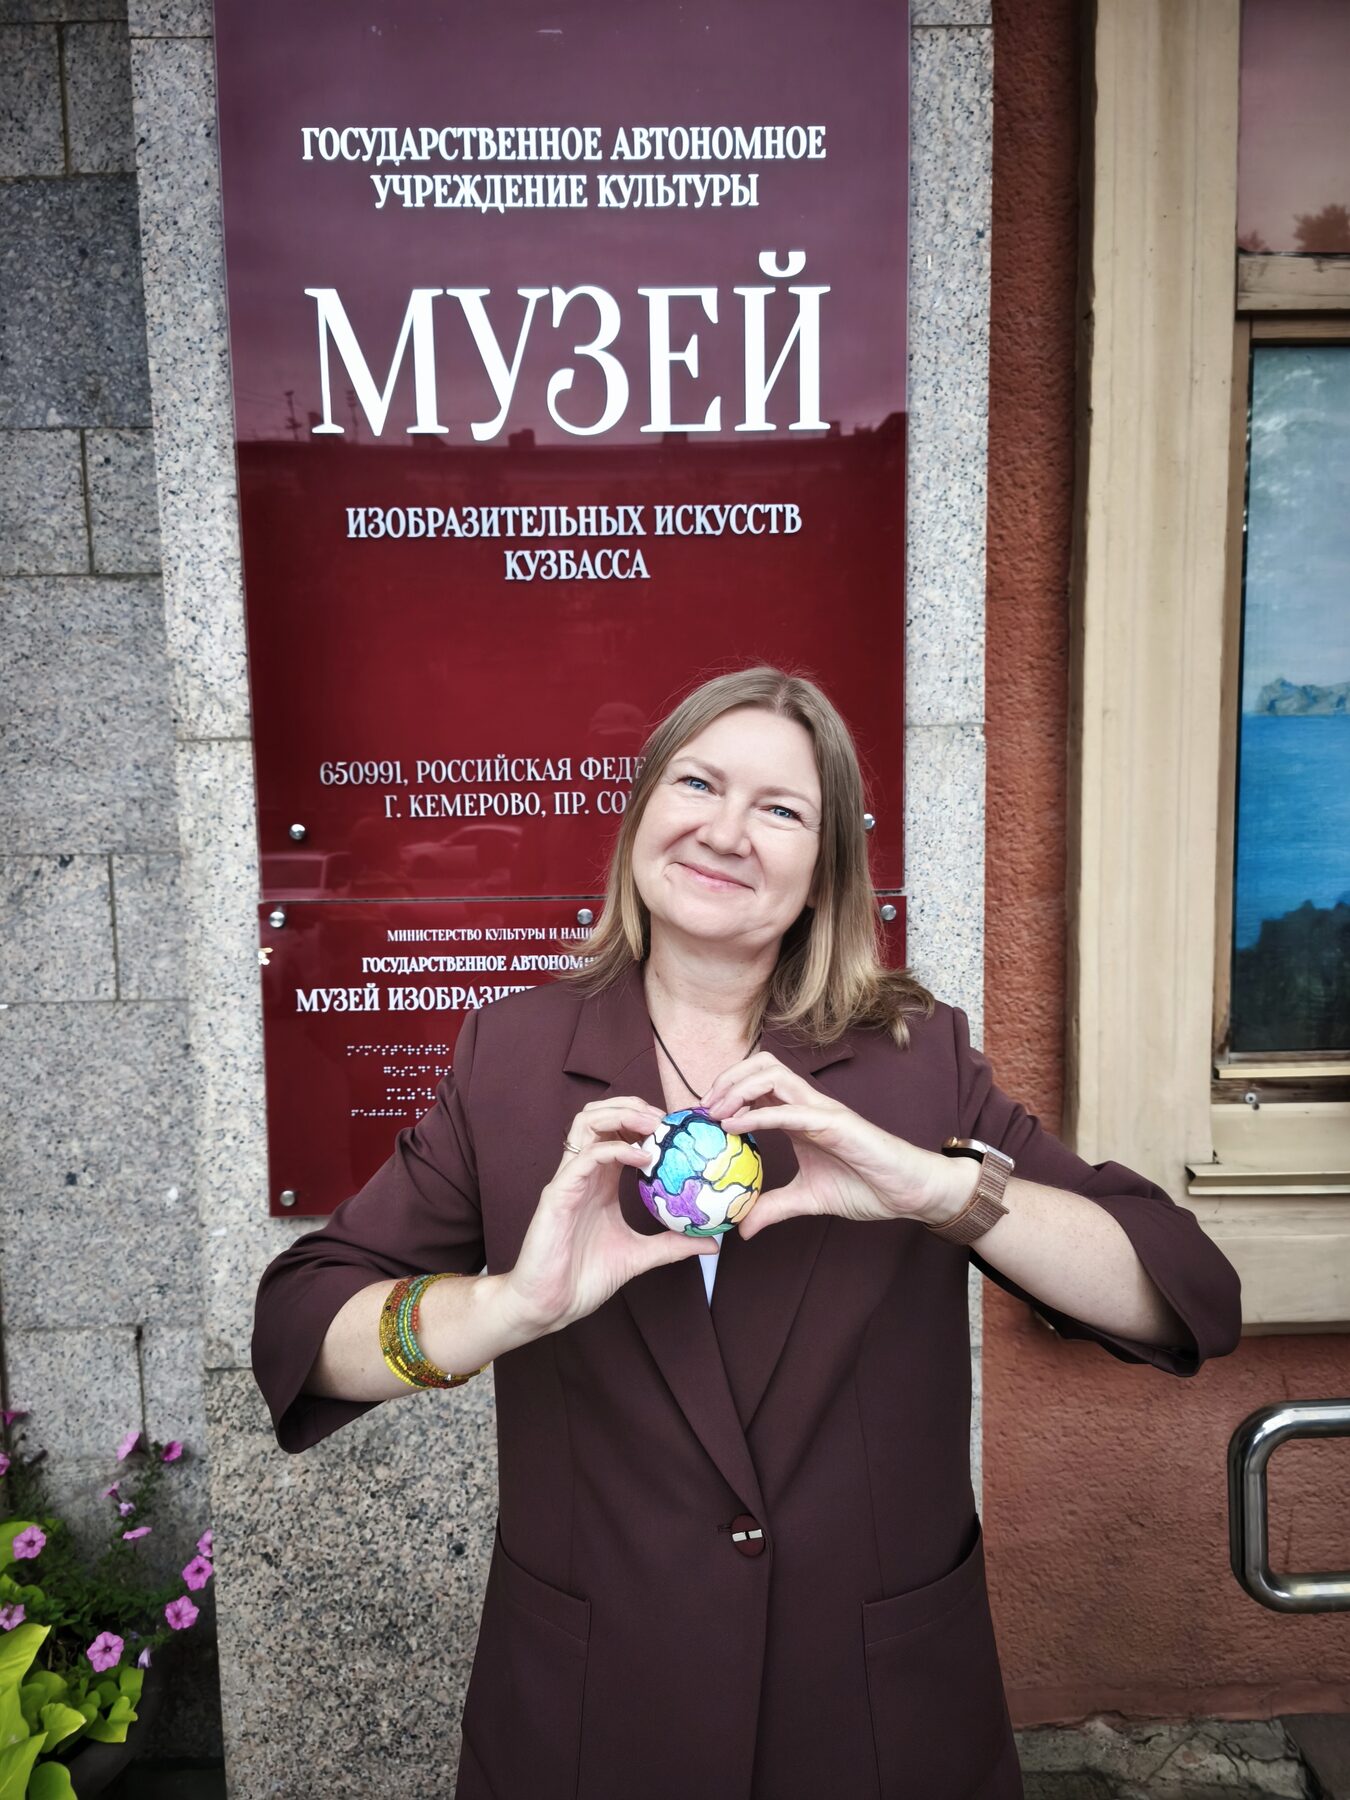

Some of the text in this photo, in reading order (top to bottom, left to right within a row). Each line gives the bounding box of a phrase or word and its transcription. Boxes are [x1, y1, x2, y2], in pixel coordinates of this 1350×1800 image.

[301, 126, 827, 166] ГОСУДАРСТВЕННОЕ АВТОНОМНОЕ
[370, 173, 760, 214] УЧРЕЖДЕНИЕ КУЛЬТУРЫ
[304, 250, 832, 441] МУЗЕЙ
[346, 504, 803, 539] ИЗОБРАЗИТЕЛЬНЫХ ИСКУССТВ
[504, 549, 651, 581] КУЗБАССА
[320, 760, 408, 785] 650991,
[416, 754, 572, 784] РОССИЙСКАЯ
[385, 790, 632, 818] Г. КЕМЕРОВО, ПР. СО
[387, 928, 482, 942] МИНИСТЕРСТВО
[485, 927, 546, 941] КУЛЬТУРЫ
[549, 927, 557, 940] И
[362, 955, 507, 975] ГОСУДАРСТВЕННОЕ
[296, 983, 537, 1012] МУЗЕЙ ИЗОБРАЗИ
